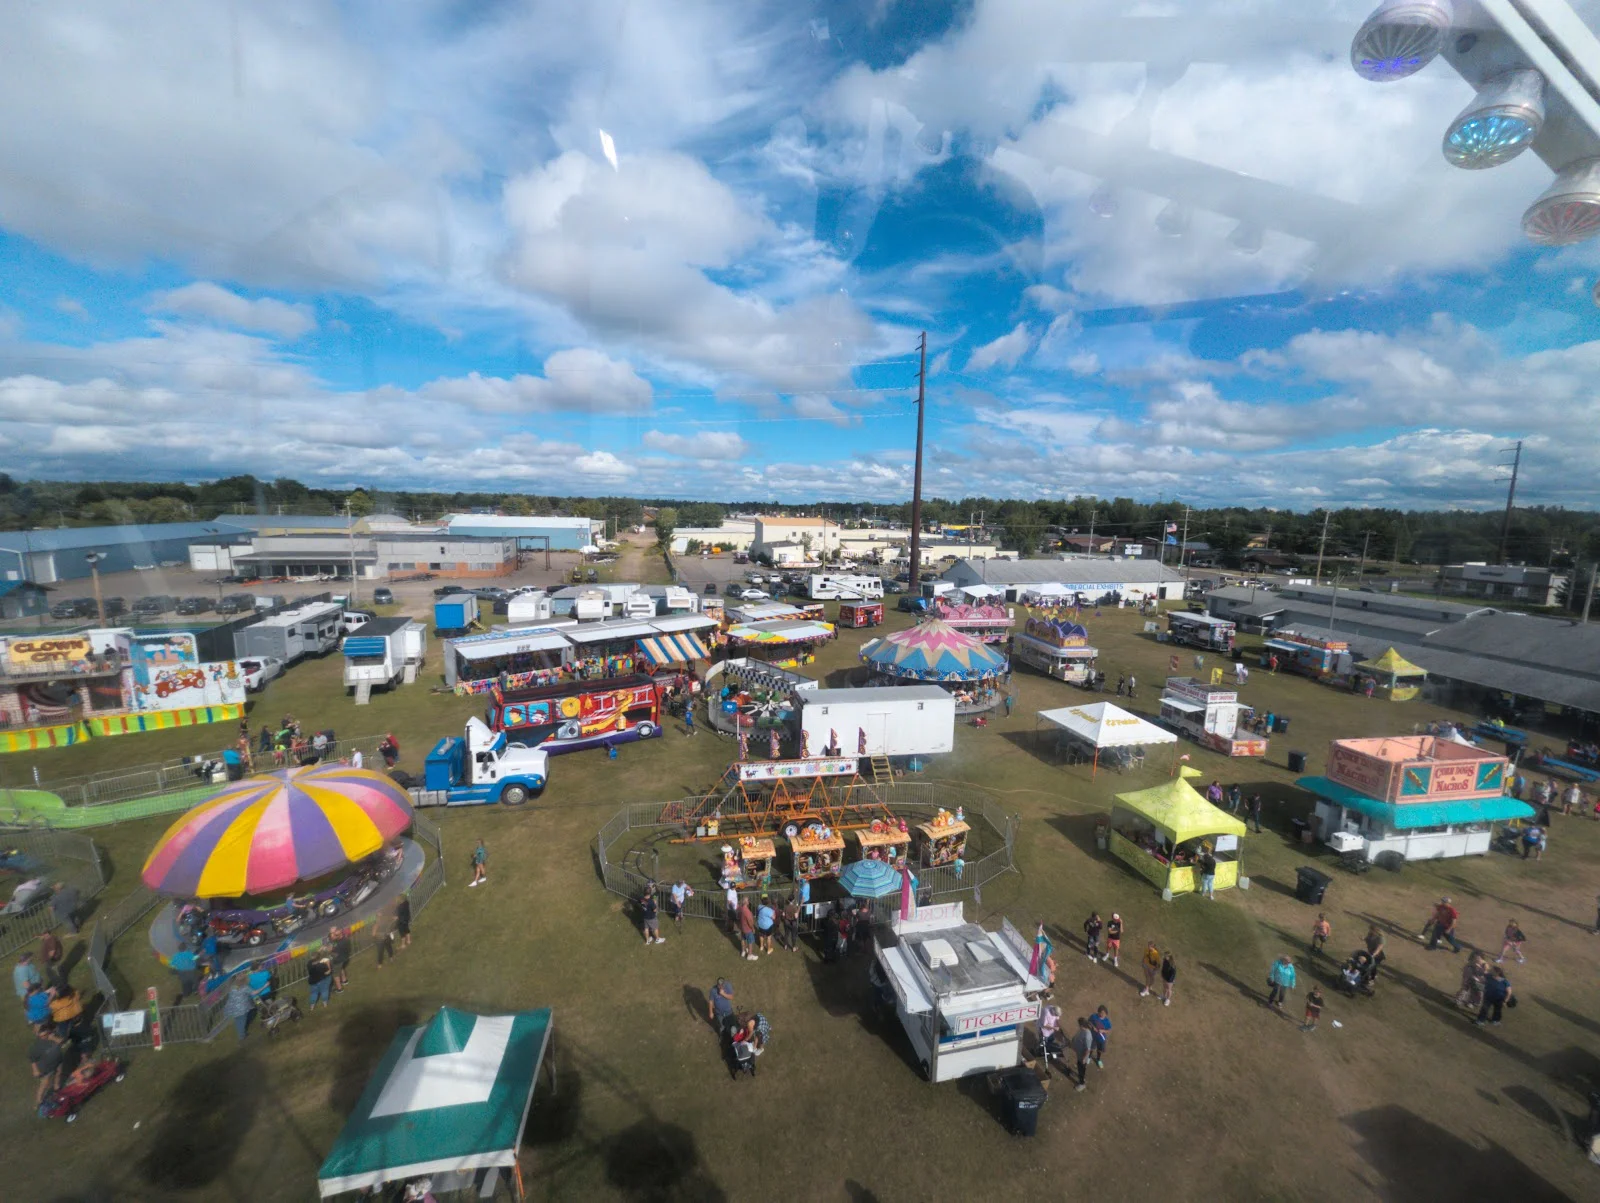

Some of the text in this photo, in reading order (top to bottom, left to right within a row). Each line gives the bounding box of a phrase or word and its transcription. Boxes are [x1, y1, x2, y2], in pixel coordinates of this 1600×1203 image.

[14, 640, 84, 653] CLOWN
[31, 651, 72, 662] CITY
[1336, 762, 1380, 787] NACHOS
[1435, 765, 1475, 779] CORN DOGS
[1435, 779, 1469, 792] NACHOS
[961, 1006, 1037, 1030] TICKETS
